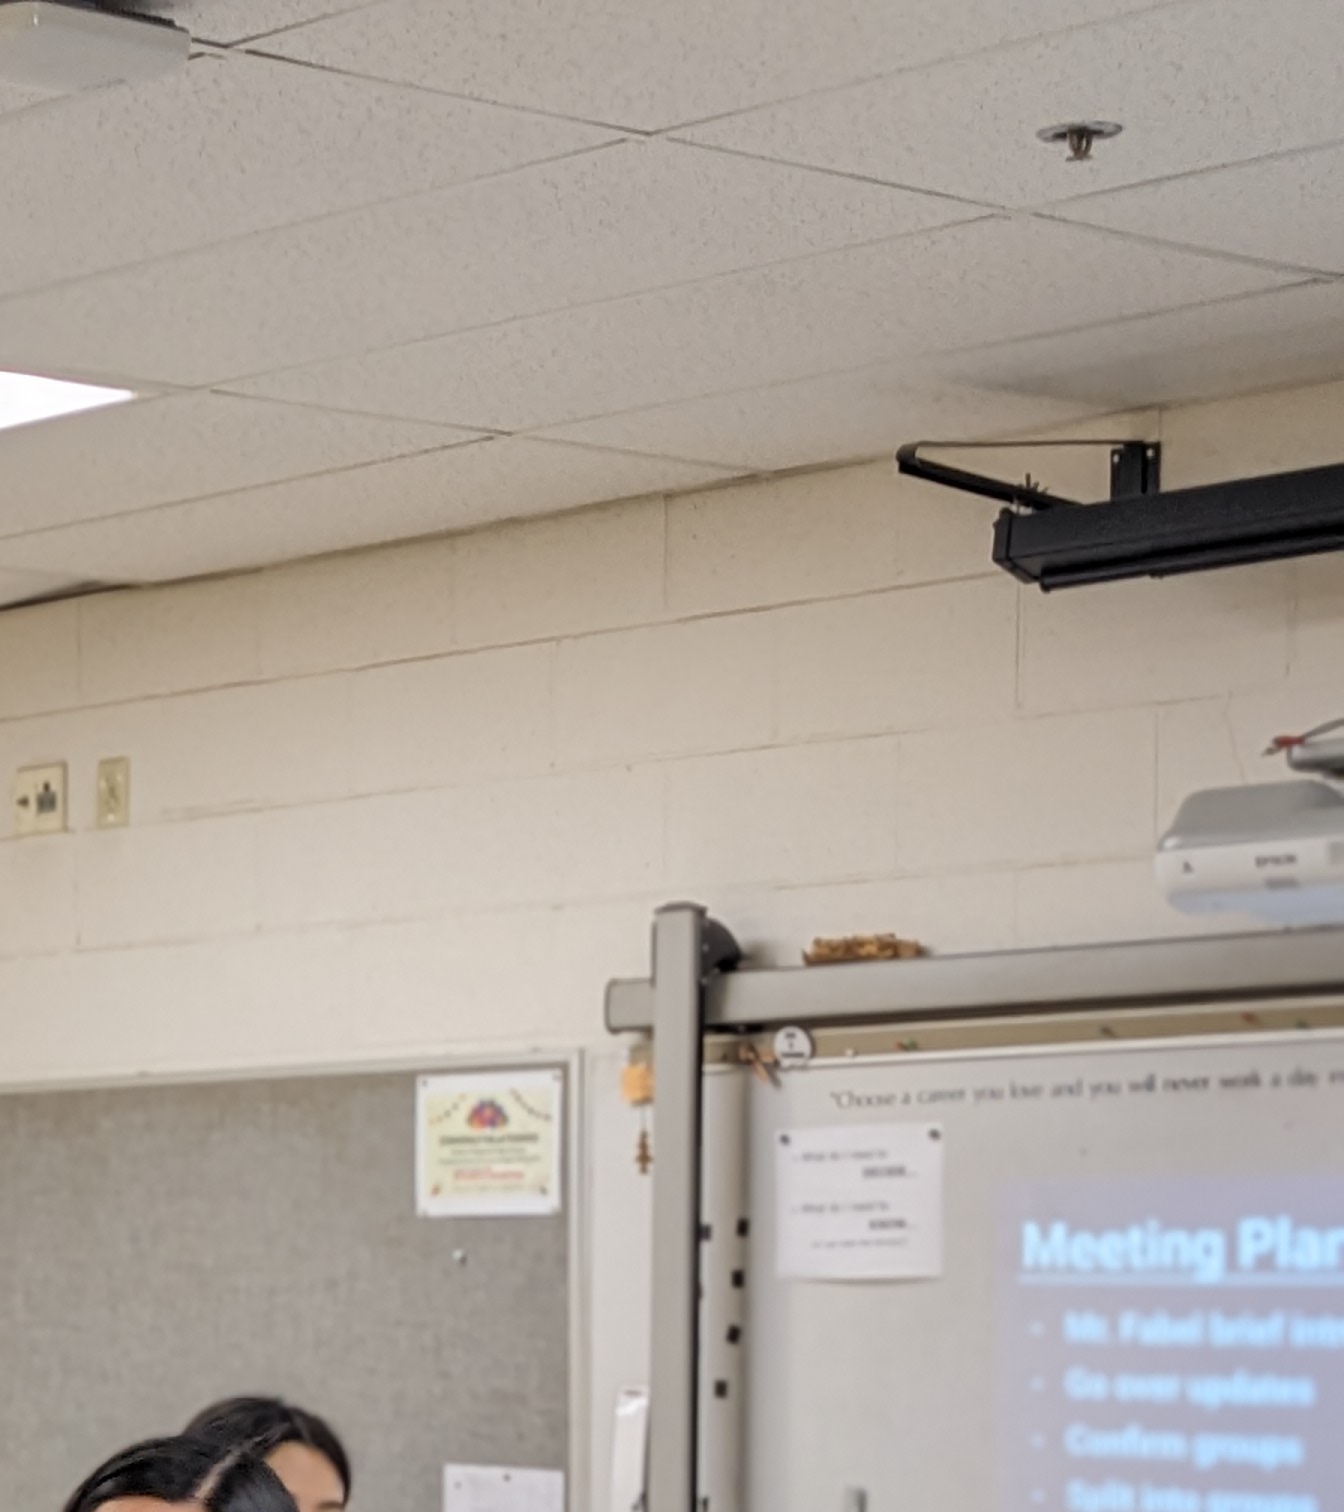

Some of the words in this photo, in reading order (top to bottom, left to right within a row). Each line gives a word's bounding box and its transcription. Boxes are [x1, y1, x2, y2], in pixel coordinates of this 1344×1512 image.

[902, 1092, 910, 1105] a
[973, 1087, 1004, 1106] you
[1009, 1079, 1044, 1099] love
[1051, 1077, 1084, 1098] and
[1090, 1082, 1121, 1101] you
[1164, 1077, 1209, 1091] never
[1271, 1072, 1282, 1087] a
[1023, 1219, 1224, 1283] Meeting
[1210, 1308, 1284, 1347] brief
[1065, 1366, 1108, 1400] Go
[1114, 1374, 1180, 1401] over
[1187, 1368, 1315, 1411] updates
[1065, 1422, 1186, 1458] Confirm
[1194, 1432, 1304, 1470] groups
